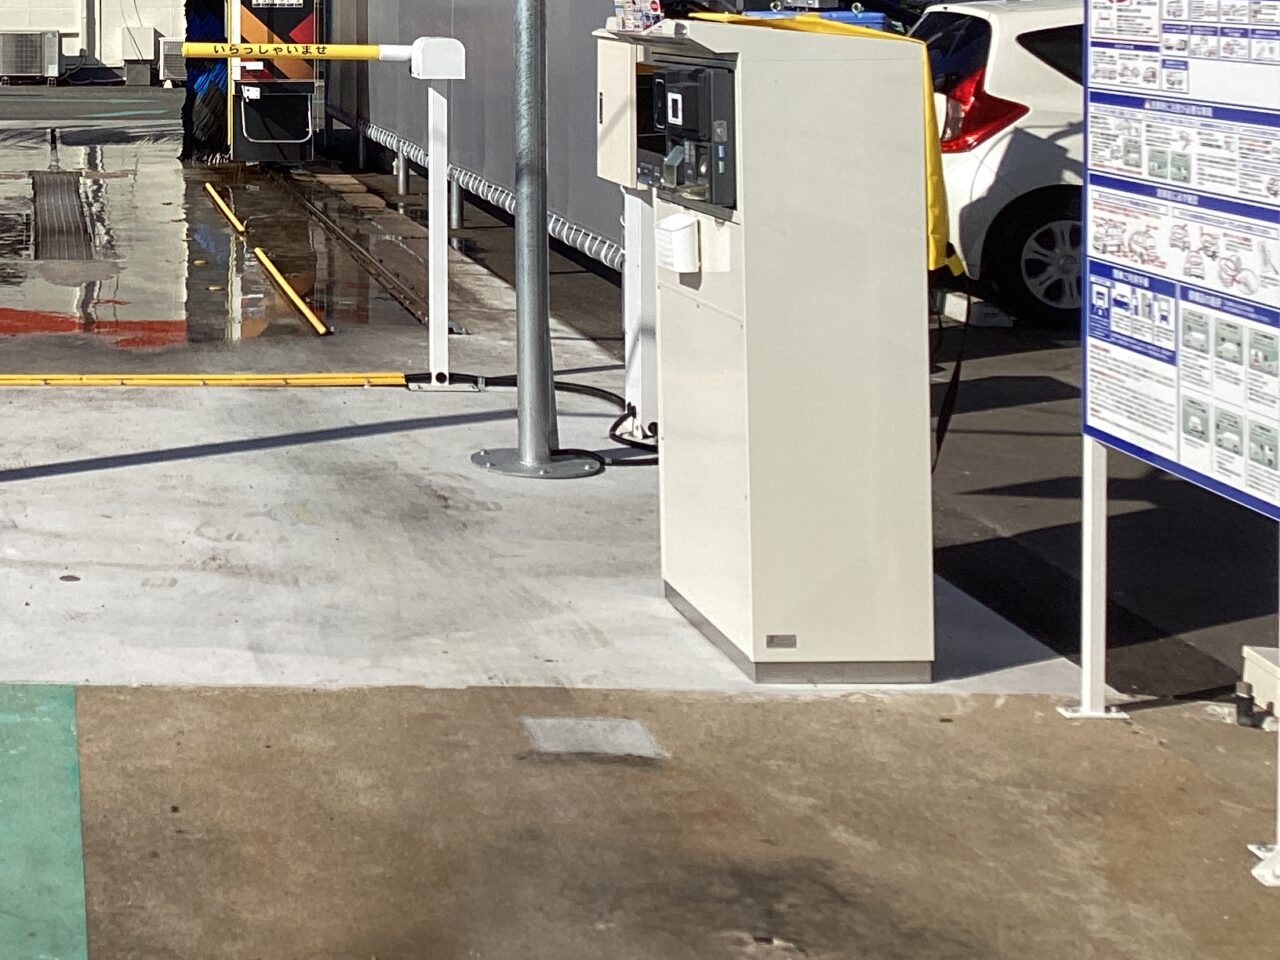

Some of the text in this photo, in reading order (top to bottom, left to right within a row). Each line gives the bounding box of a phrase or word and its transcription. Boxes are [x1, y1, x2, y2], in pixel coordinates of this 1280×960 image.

[213, 45, 327, 55] いらっしゃいませ
